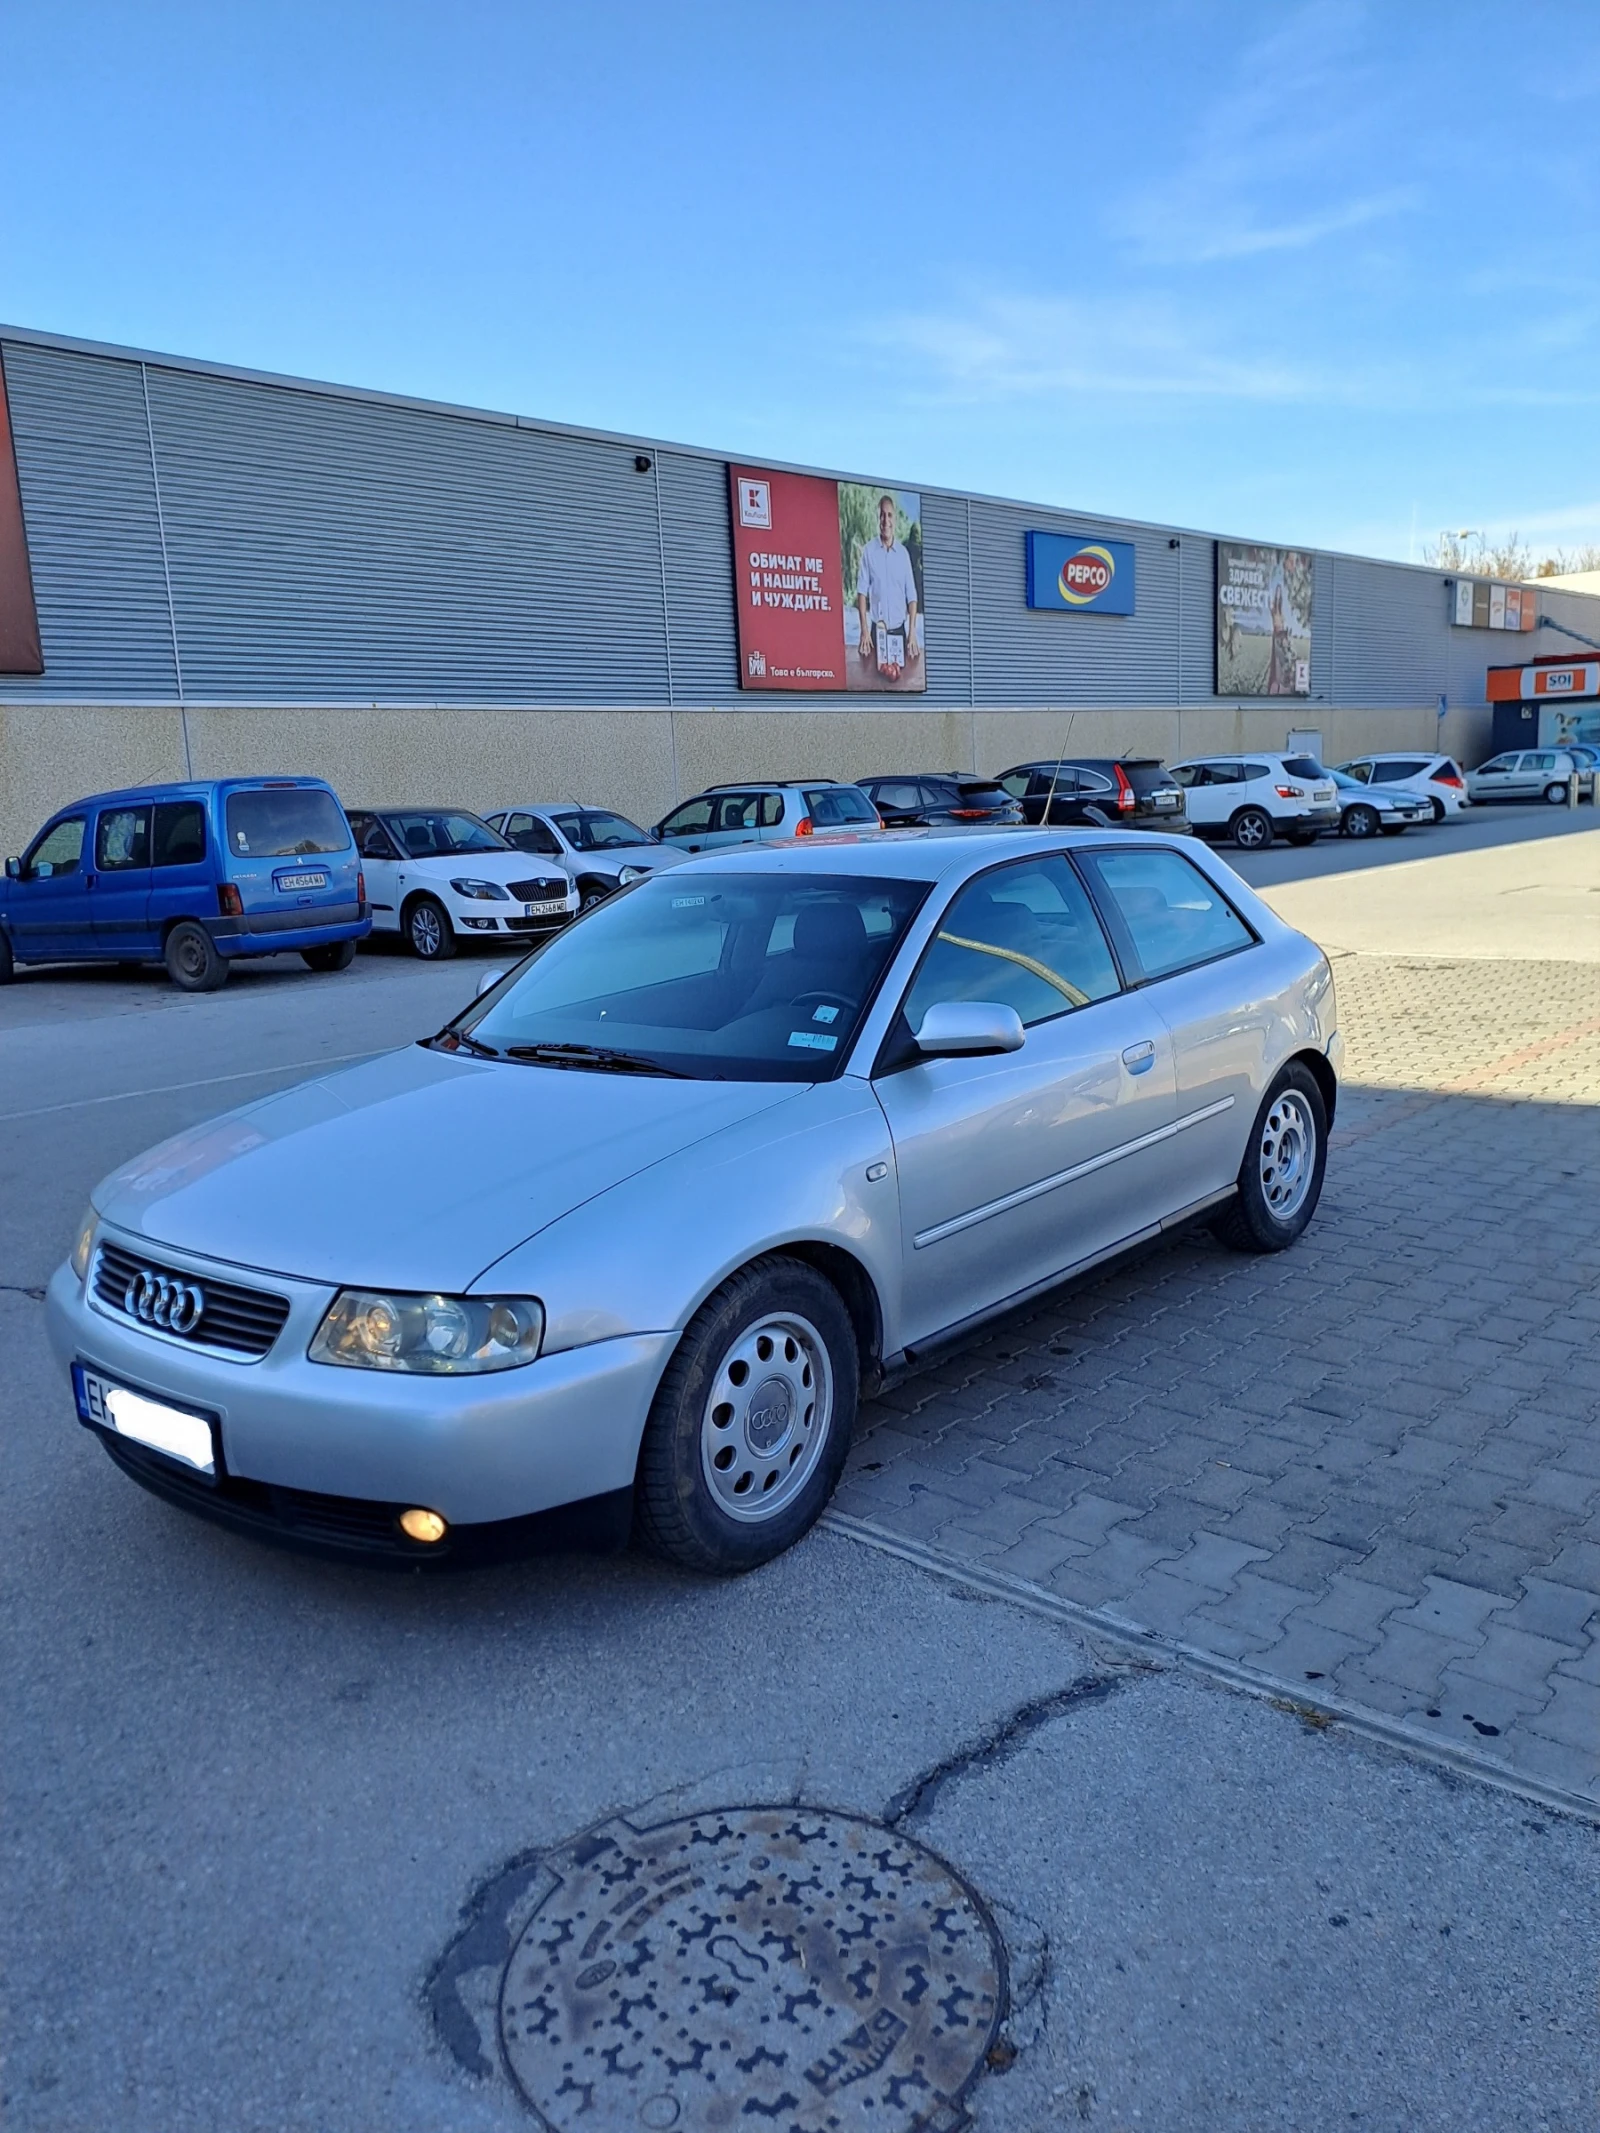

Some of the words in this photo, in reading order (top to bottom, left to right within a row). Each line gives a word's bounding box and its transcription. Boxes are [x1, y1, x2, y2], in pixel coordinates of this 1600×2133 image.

[749, 552, 802, 571] ОБИЧАТ
[805, 557, 823, 573] МЕ
[750, 571, 760, 587] И
[763, 573, 822, 594] НАШИТЕ,
[1067, 563, 1107, 586] PEPCO
[751, 591, 761, 606] И
[764, 592, 832, 612] ЧУЖДИТЕ.
[770, 666, 788, 677] Това
[796, 667, 835, 680] българско.
